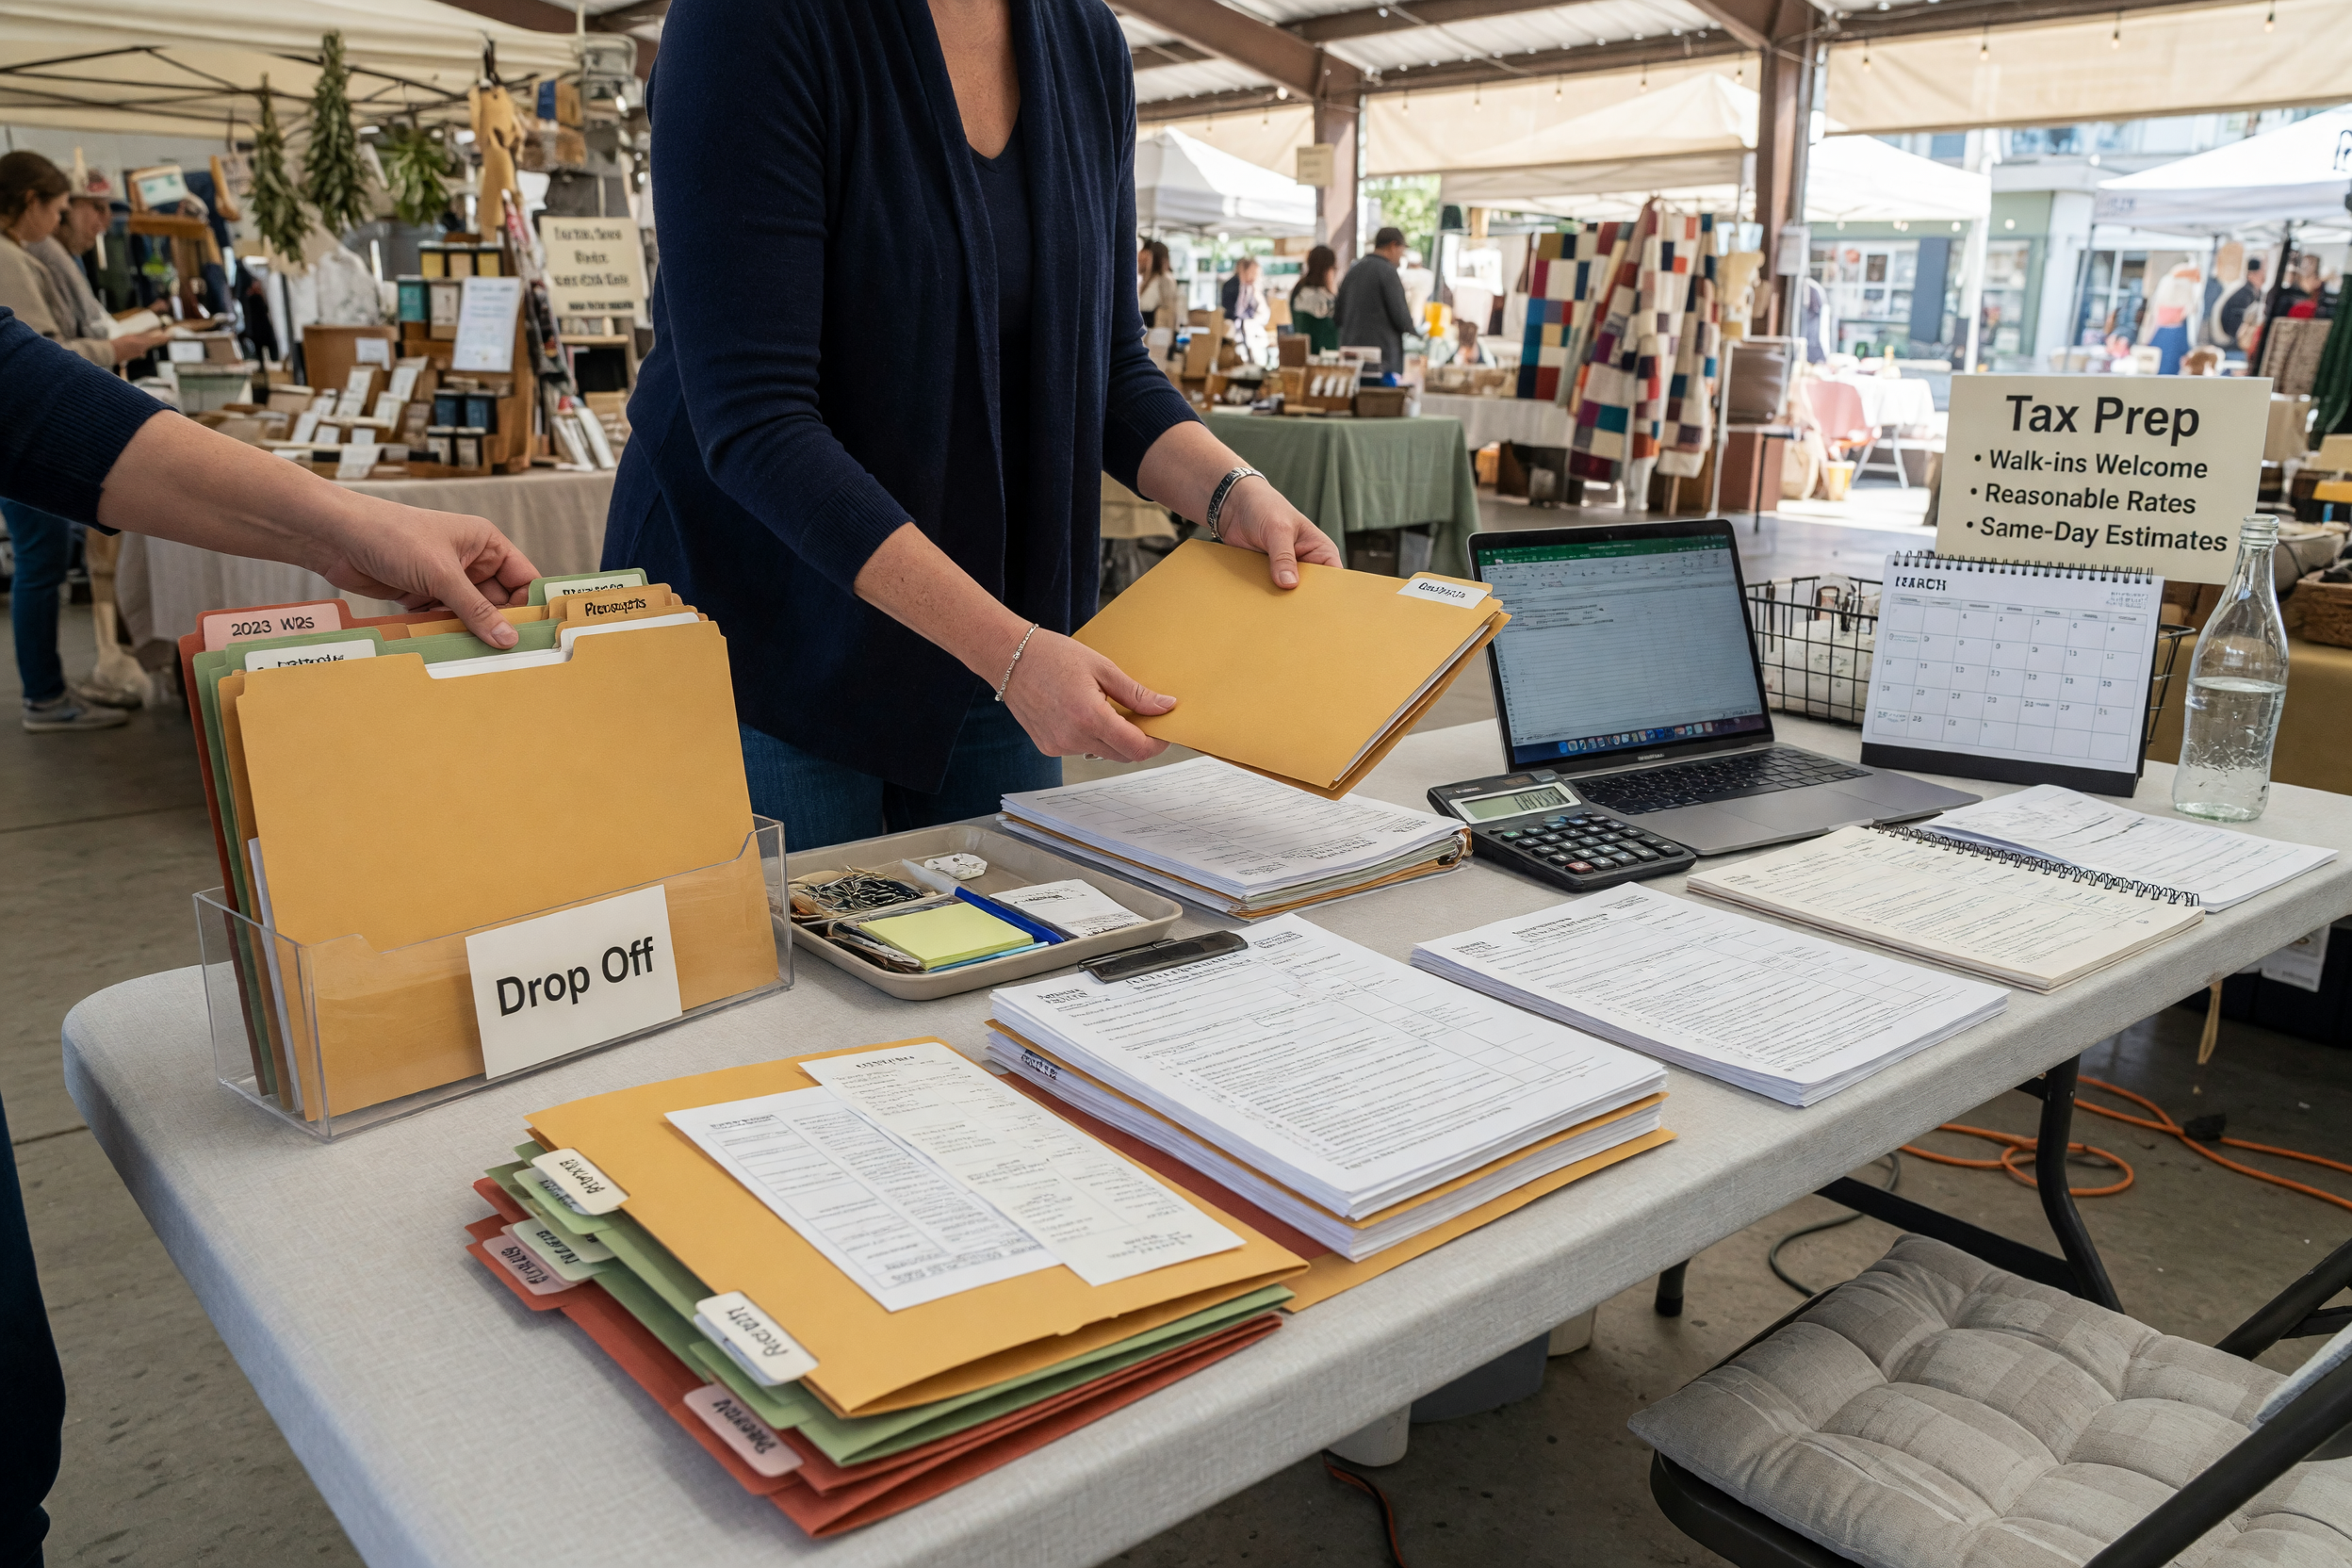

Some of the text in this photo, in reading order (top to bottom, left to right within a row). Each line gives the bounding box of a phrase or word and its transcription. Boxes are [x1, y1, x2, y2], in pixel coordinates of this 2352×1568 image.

[2005, 395, 2200, 447] Tax Prep
[1989, 449, 2208, 478] Walk-ins Welcome
[1984, 483, 2197, 514] Reasonable Rates
[1980, 516, 2229, 551] Same-Day Estimates
[231, 620, 272, 636] 2023
[496, 936, 654, 1017] Drop Off
